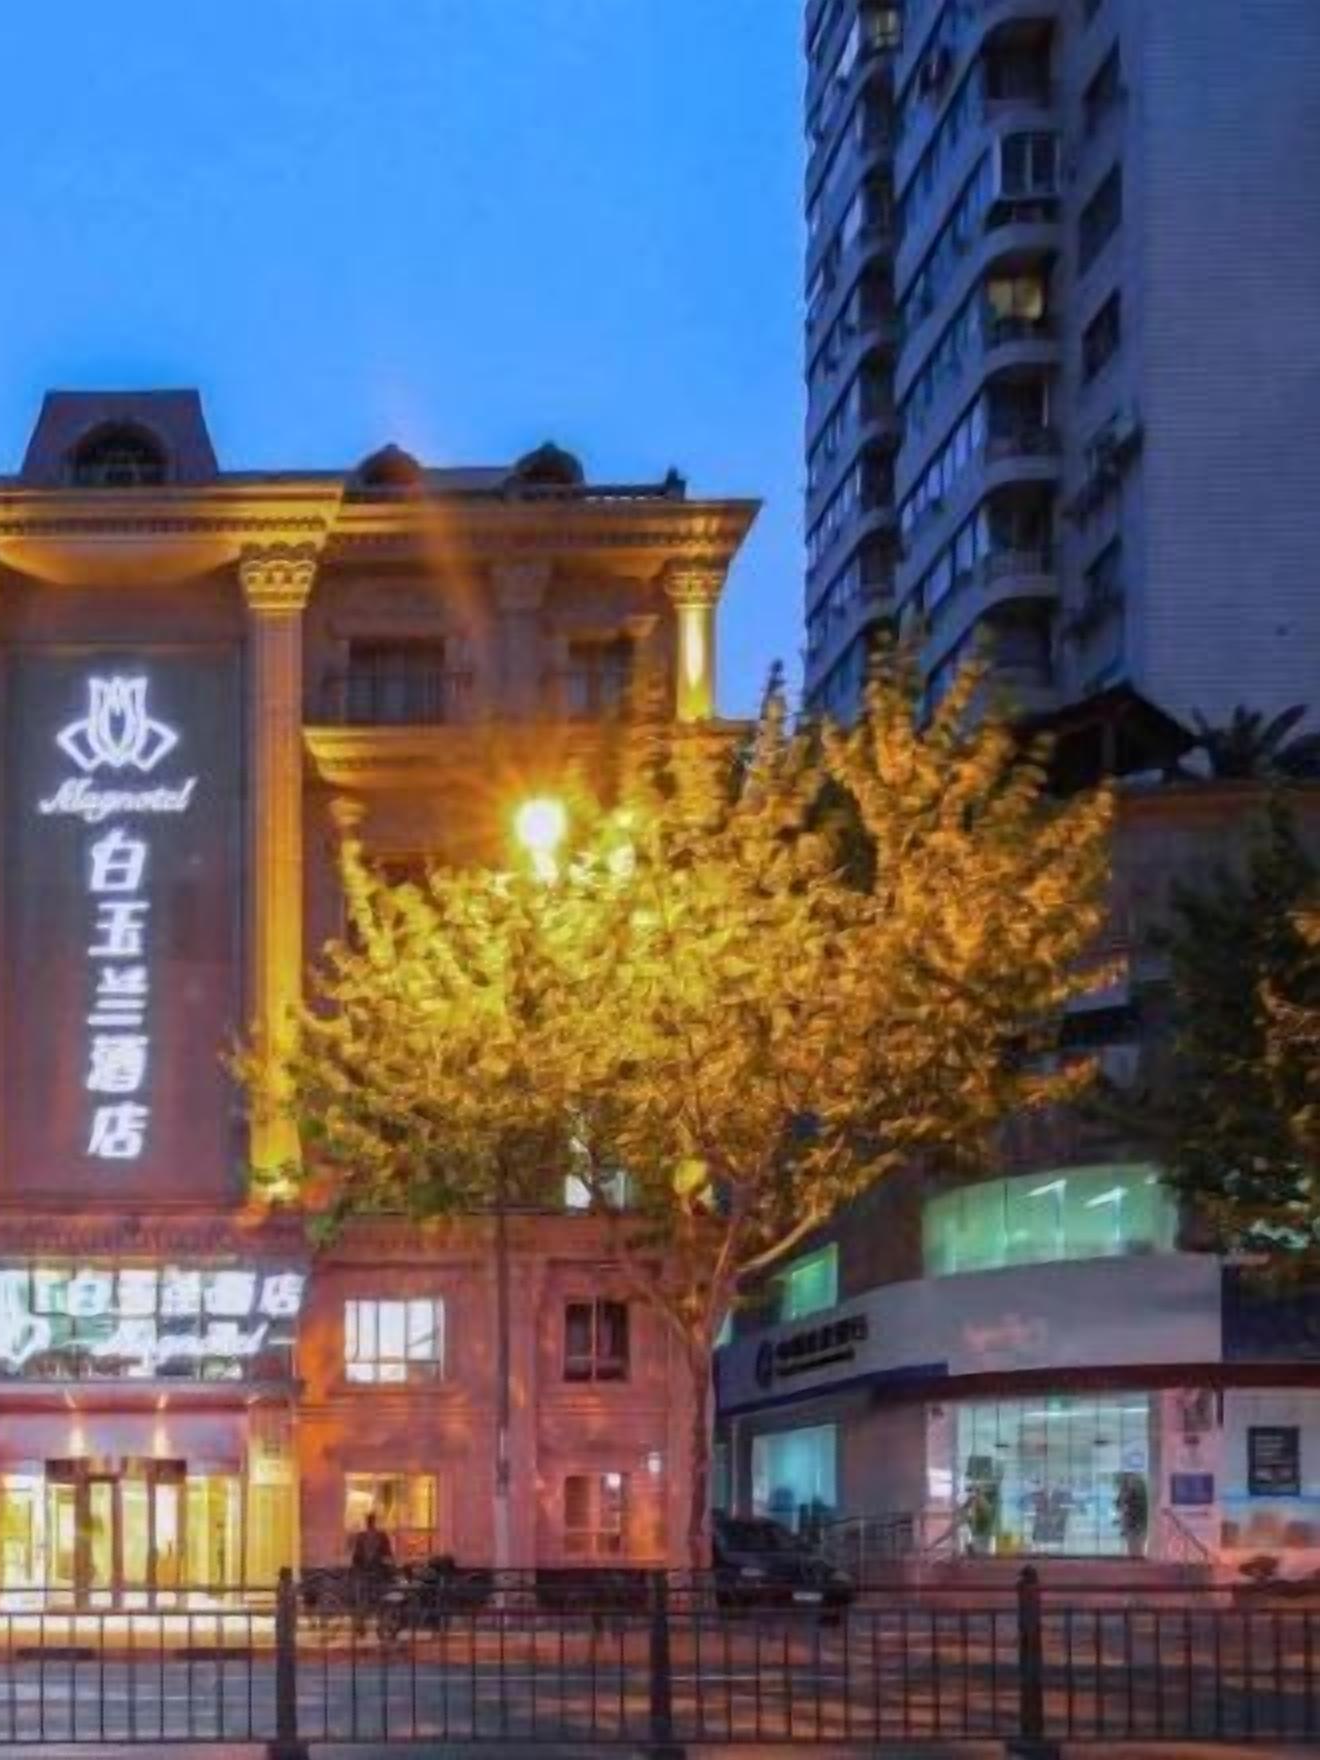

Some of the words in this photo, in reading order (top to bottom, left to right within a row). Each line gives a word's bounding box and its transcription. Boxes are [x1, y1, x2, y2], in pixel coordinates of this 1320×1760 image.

[87, 829, 150, 1158] 白玉兰酒店
[67, 1268, 305, 1316] 白酒店
